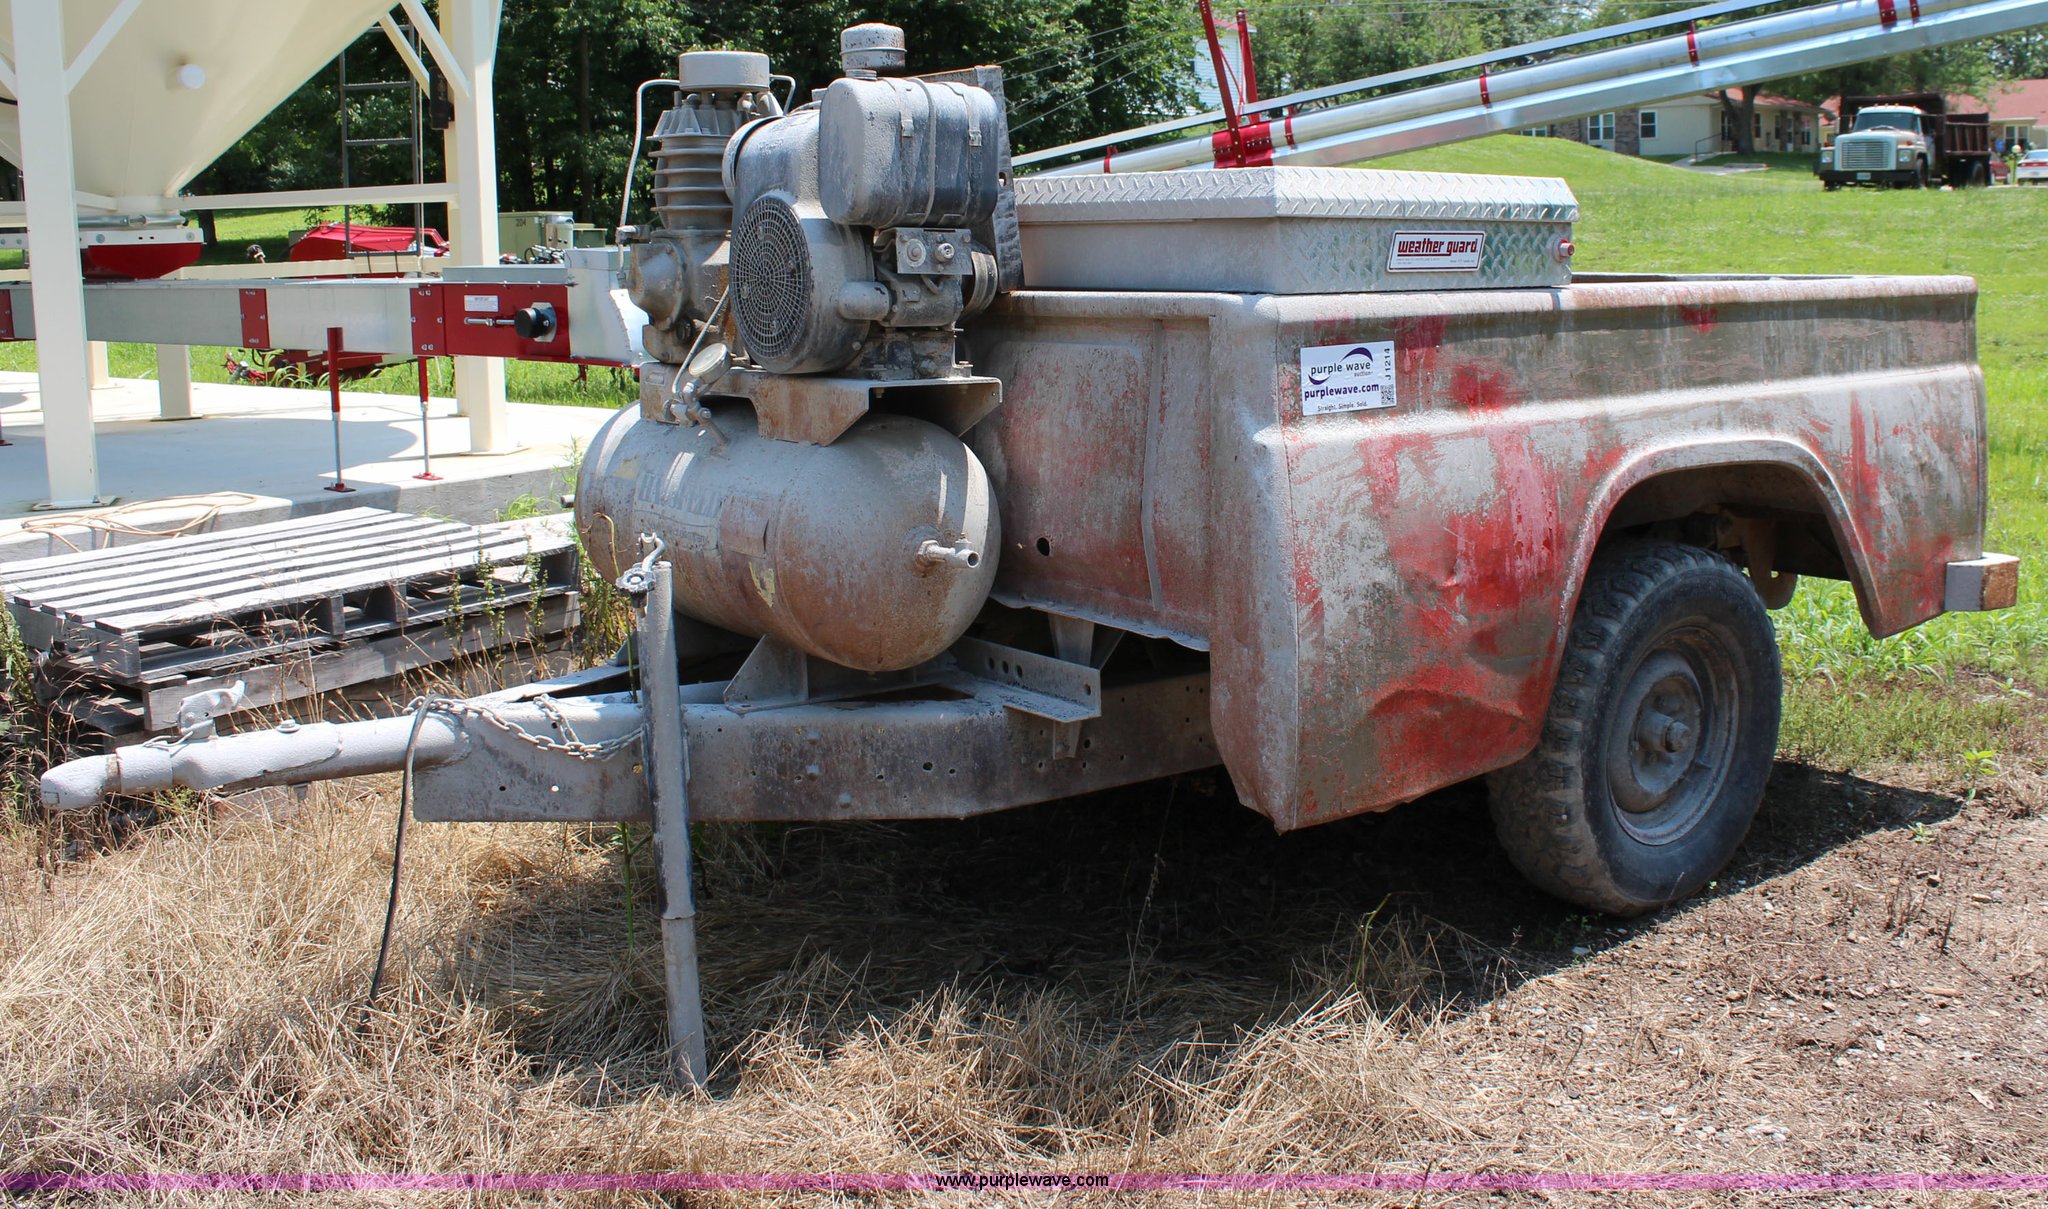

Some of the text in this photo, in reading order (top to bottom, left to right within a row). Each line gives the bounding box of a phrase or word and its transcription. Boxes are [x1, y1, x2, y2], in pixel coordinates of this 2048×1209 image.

[1397, 238, 1478, 254] weather guard
[1311, 361, 1371, 376] purple wave
[1304, 383, 1379, 401] purplewave.com
